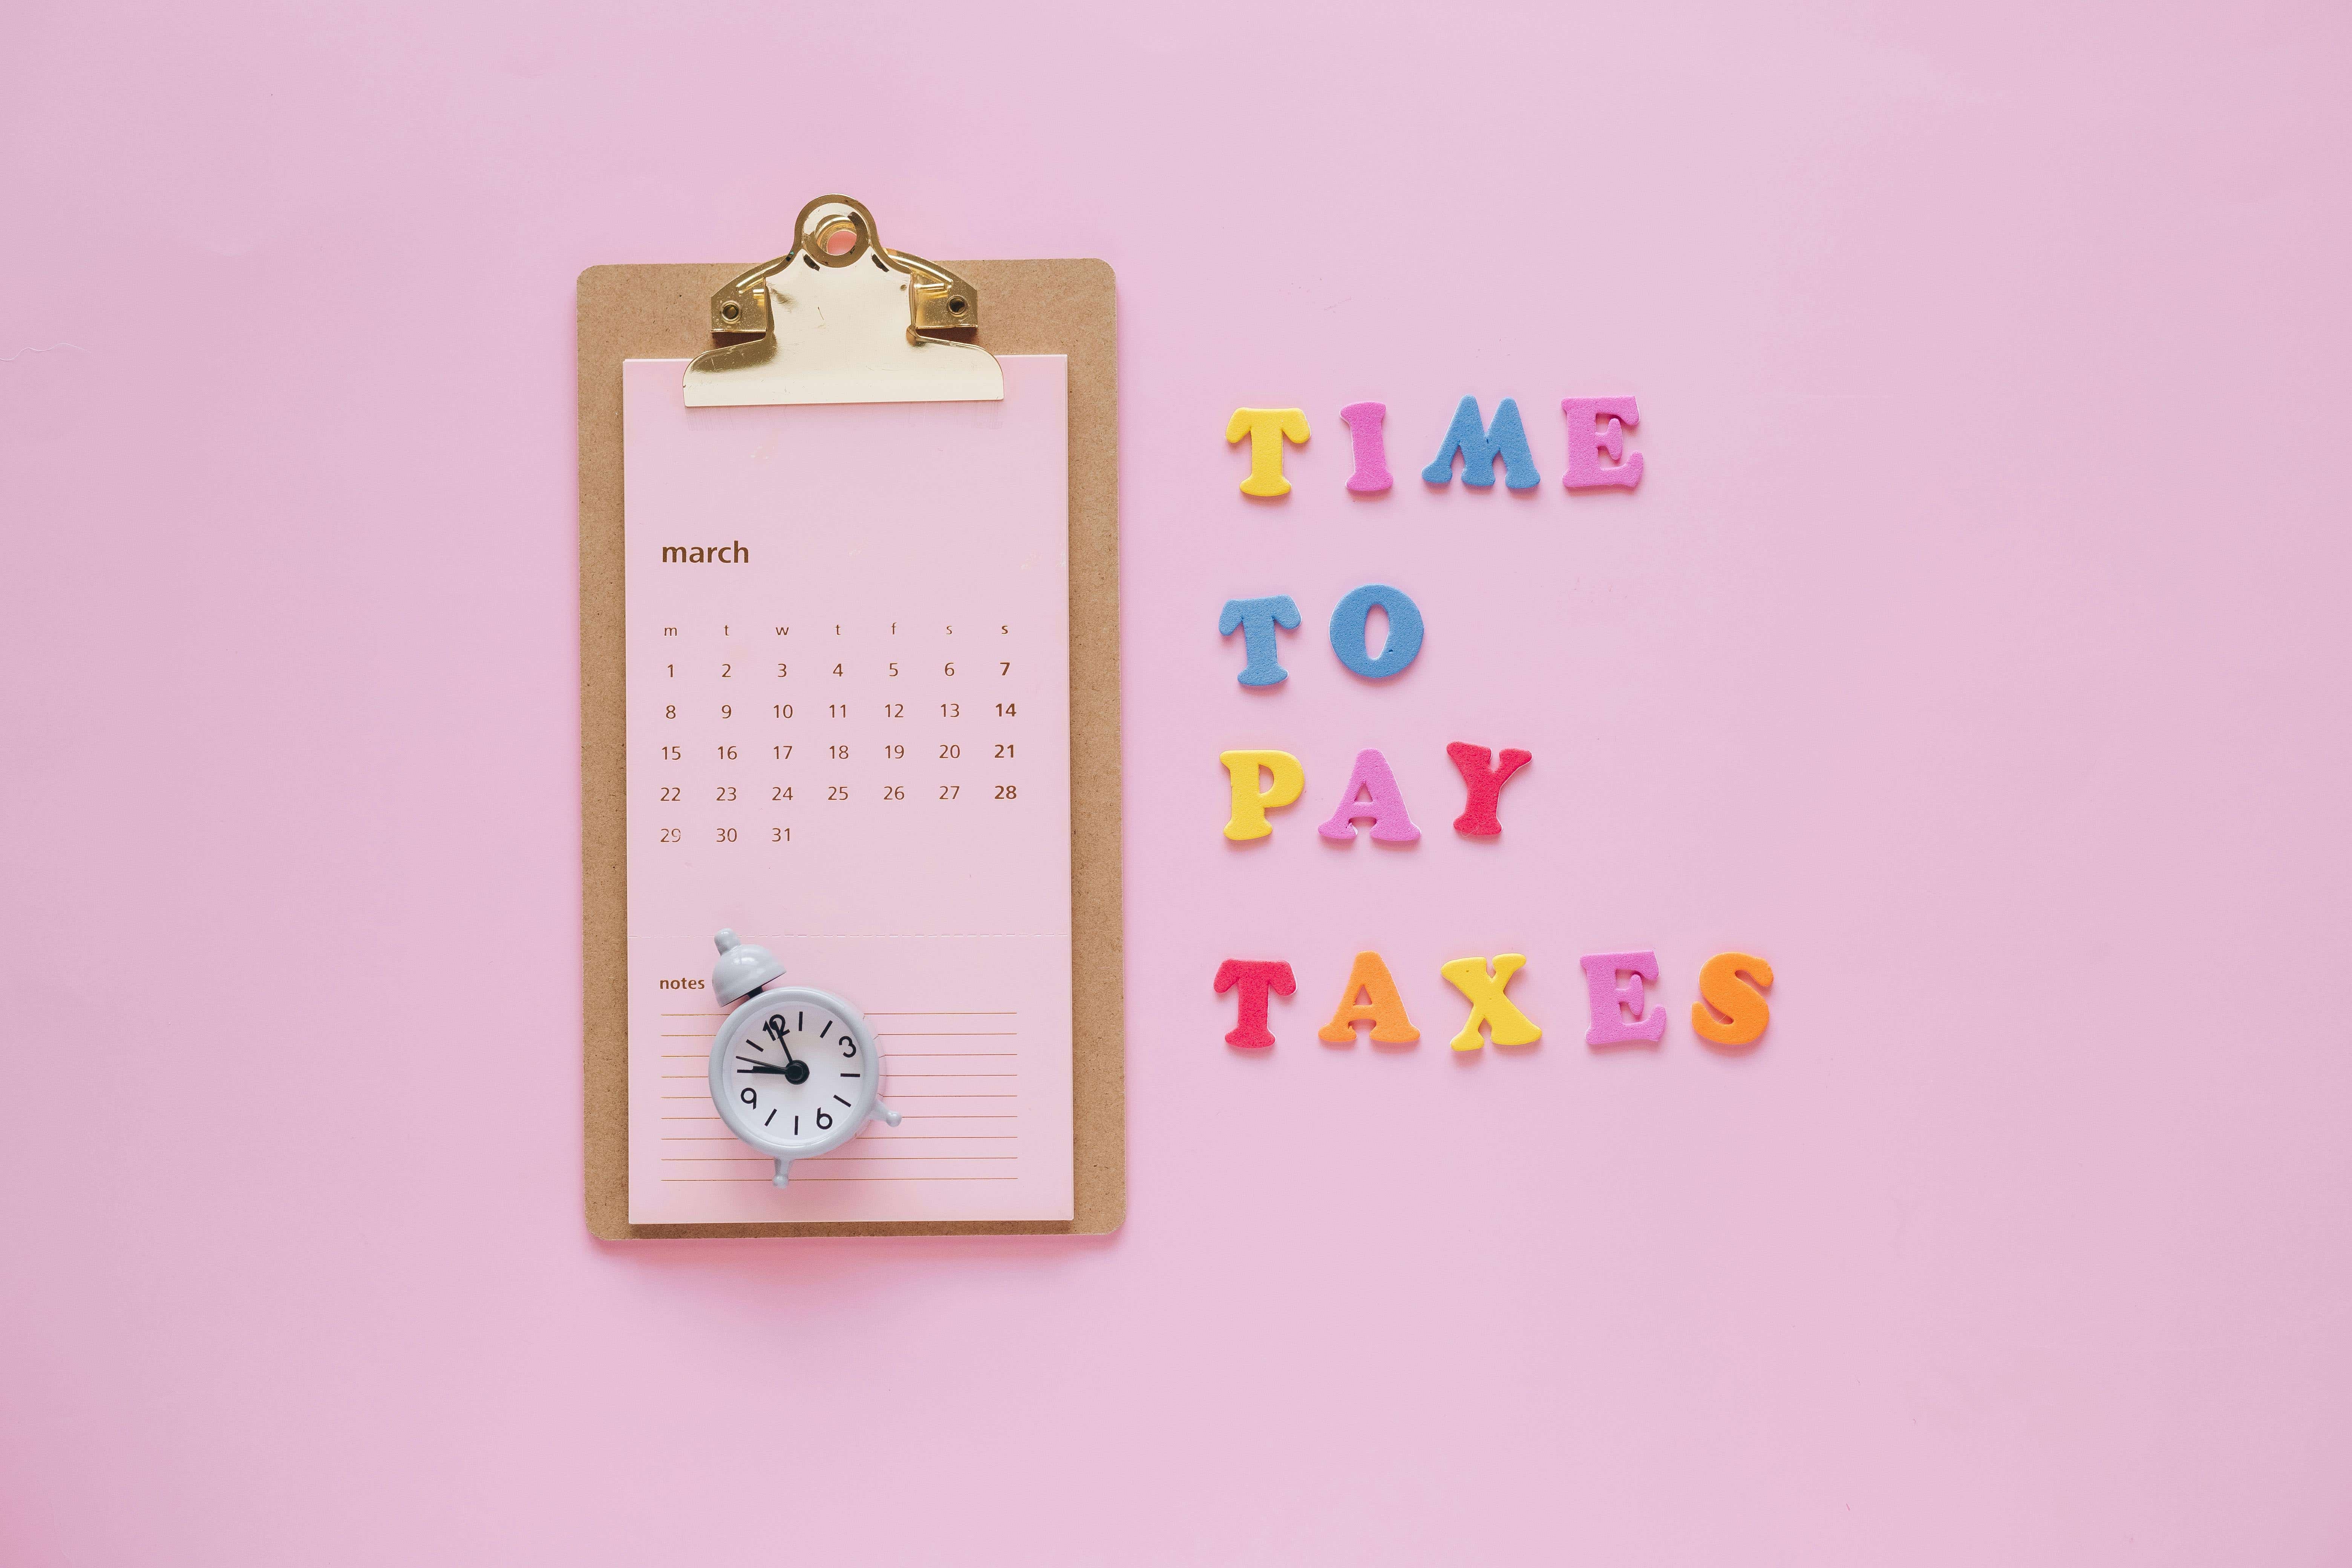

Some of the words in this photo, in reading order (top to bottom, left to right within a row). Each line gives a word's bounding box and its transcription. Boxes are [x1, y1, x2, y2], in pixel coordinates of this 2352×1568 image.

[1225, 394, 1645, 498] TIME
[663, 541, 749, 564] march
[664, 627, 678, 637] m
[724, 625, 730, 637] t
[775, 627, 790, 636] w
[835, 624, 842, 636] t
[891, 622, 897, 636] f
[946, 626, 953, 635] s
[1001, 625, 1009, 635] s
[1218, 583, 1424, 686] TO
[667, 664, 674, 678] 1
[722, 663, 732, 678] 2
[777, 663, 787, 678] 3
[833, 663, 844, 678] 4
[889, 663, 899, 677] 5
[945, 662, 956, 677] 6
[1000, 662, 1011, 677] 7
[666, 705, 677, 720] 8
[721, 704, 732, 720] 9
[773, 704, 794, 719] 10
[829, 704, 847, 719] 11
[885, 704, 905, 718] 12
[941, 703, 960, 718] 13
[995, 703, 1018, 718] 14
[662, 746, 682, 761] 15
[717, 746, 738, 761] 16
[773, 746, 793, 760] 17
[829, 745, 850, 760] 18
[885, 745, 905, 760] 19
[939, 744, 961, 760] 20
[994, 744, 1015, 759] 21
[660, 787, 681, 802] 22
[716, 787, 737, 802] 23
[772, 787, 794, 801] 24
[828, 786, 849, 801] 25
[884, 786, 905, 801] 26
[939, 786, 960, 801] 27
[994, 785, 1018, 800] 28
[1219, 741, 1532, 842] PAY
[660, 828, 682, 843] 29
[716, 828, 738, 843] 30
[772, 828, 791, 843] 31
[660, 977, 706, 991] notes
[1213, 950, 1774, 1052] TAXES
[762, 1014, 790, 1041] 12
[838, 1035, 856, 1058] 3
[740, 1087, 758, 1110] 9
[816, 1107, 833, 1130] 6
